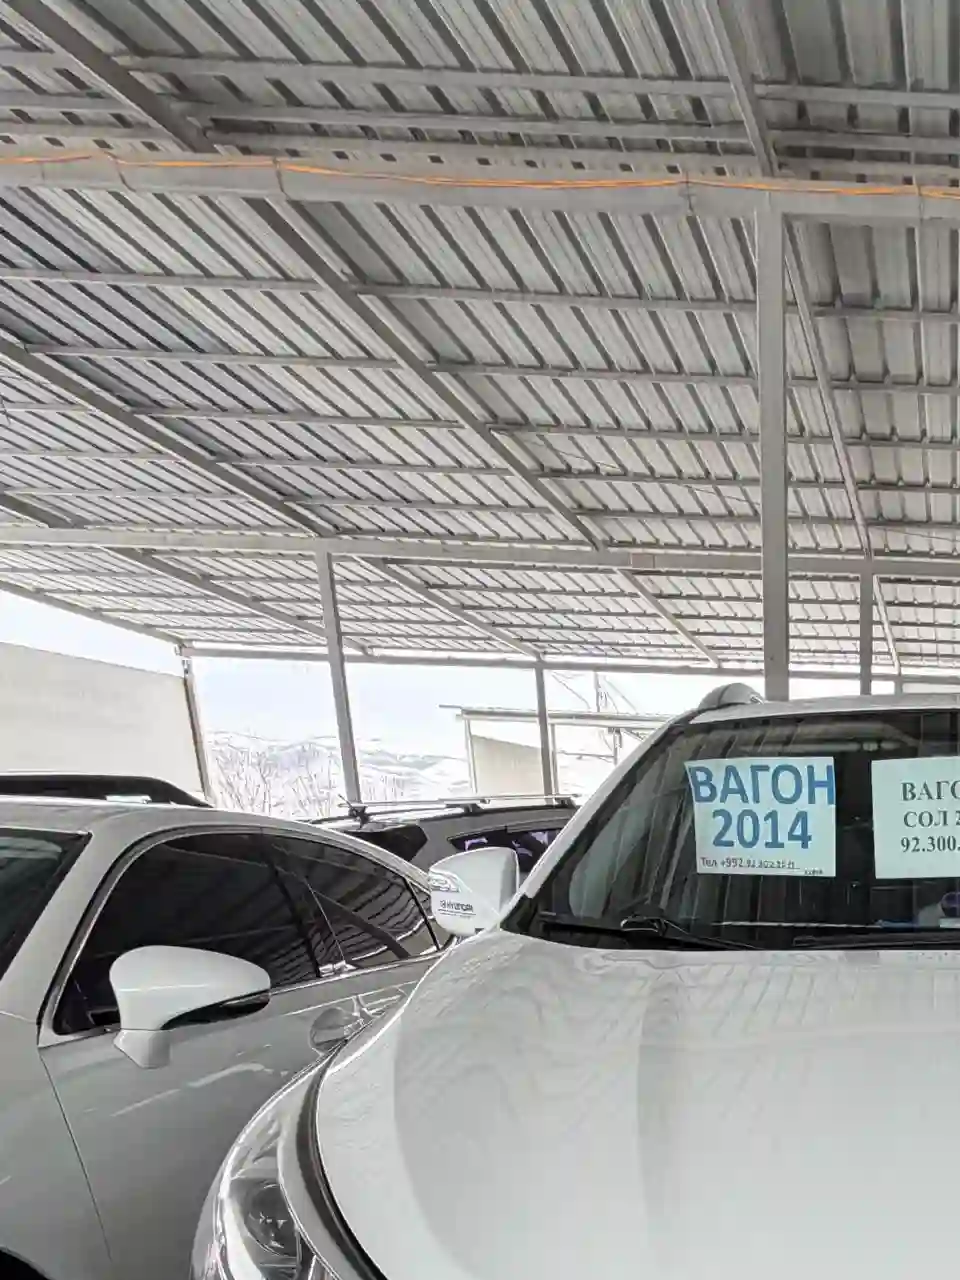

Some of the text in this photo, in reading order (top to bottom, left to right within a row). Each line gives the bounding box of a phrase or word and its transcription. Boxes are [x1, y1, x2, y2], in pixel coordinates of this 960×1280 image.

[688, 764, 835, 805] ВАГОН
[712, 808, 812, 849] 2014
[903, 811, 949, 828] СОЛ
